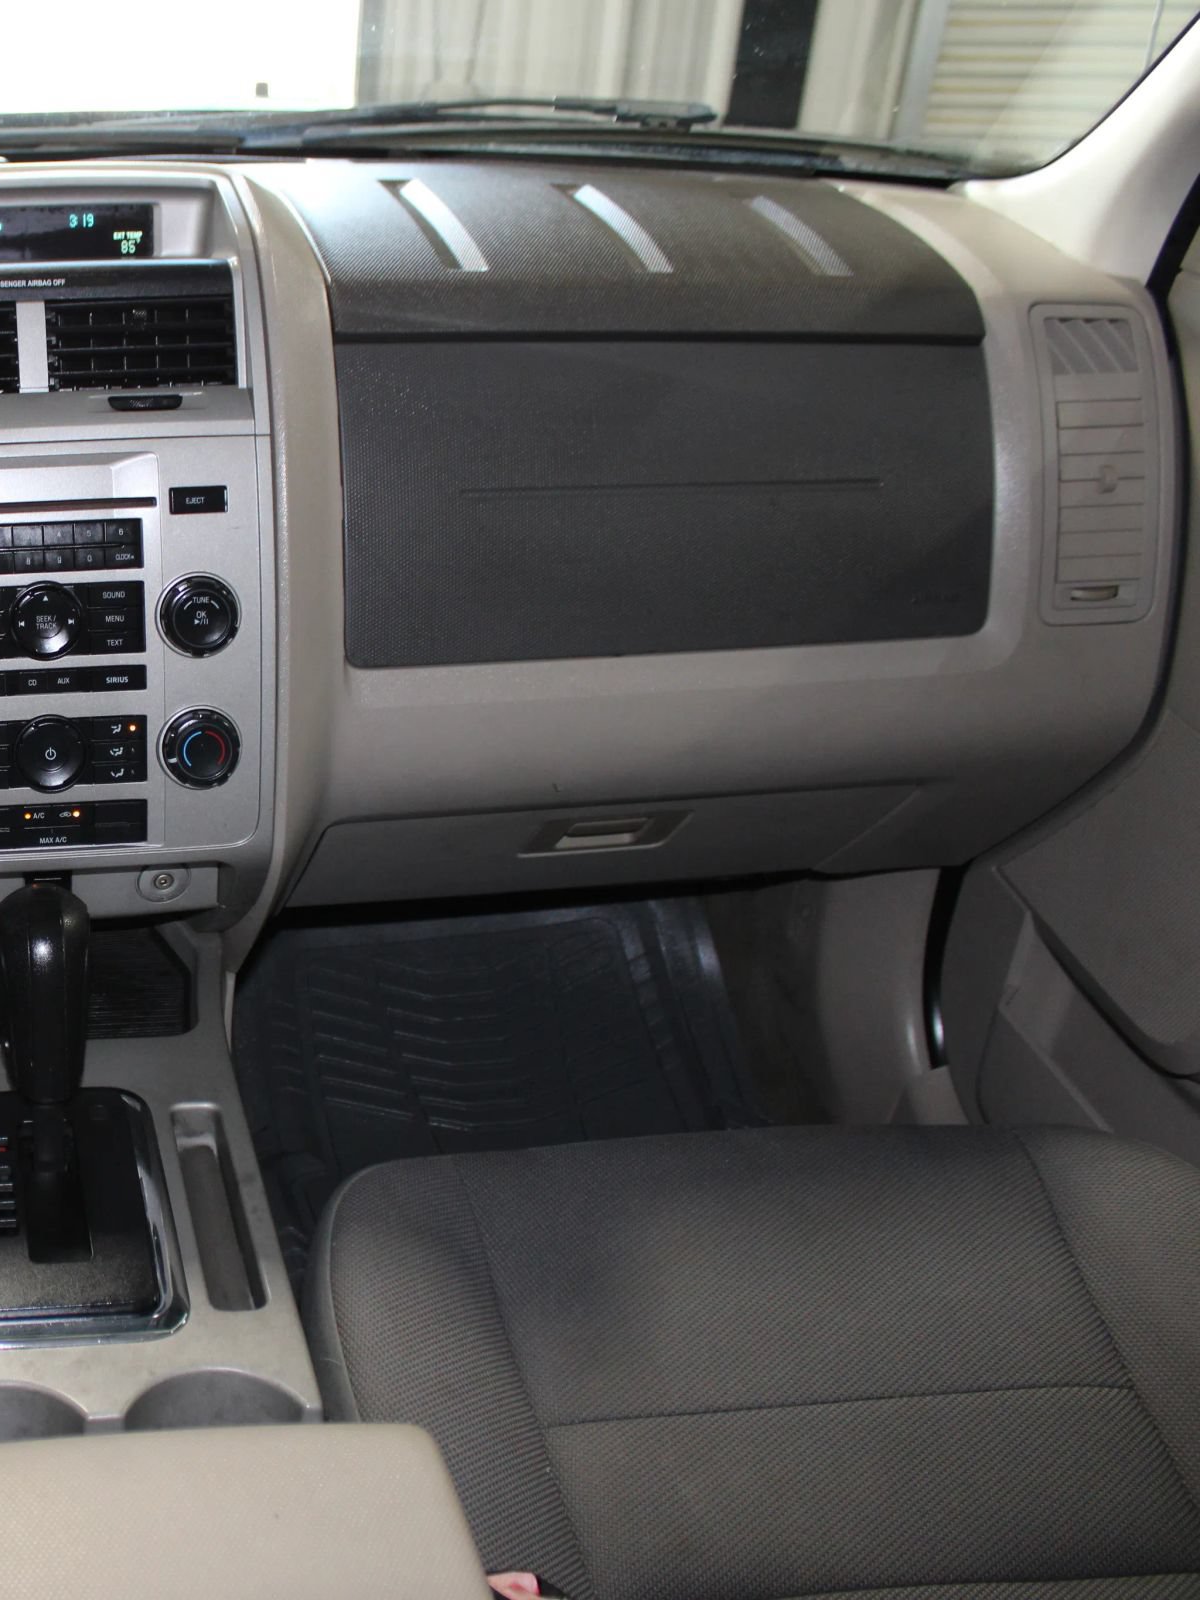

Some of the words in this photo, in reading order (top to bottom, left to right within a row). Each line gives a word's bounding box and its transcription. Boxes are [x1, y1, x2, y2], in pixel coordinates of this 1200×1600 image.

[27, 279, 51, 287] AIRBAG
[53, 278, 66, 286] OFF
[185, 497, 205, 505] EJECT
[118, 528, 124, 536] 6
[87, 554, 93, 562] 0
[102, 591, 126, 599] SOUND
[36, 622, 57, 630] TRACK
[106, 676, 128, 684] SIRIUS
